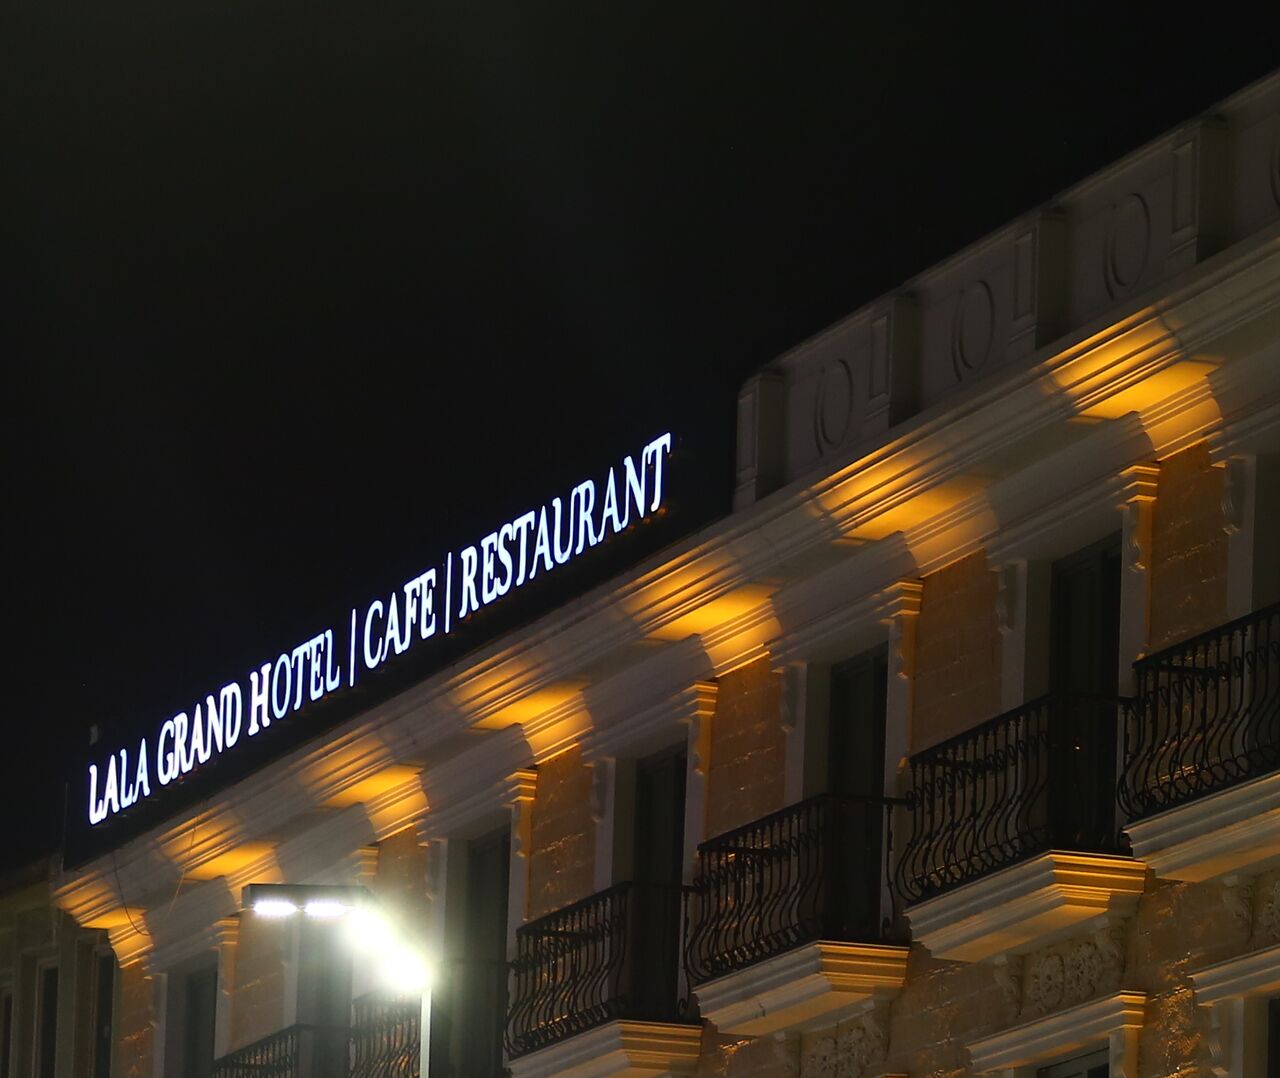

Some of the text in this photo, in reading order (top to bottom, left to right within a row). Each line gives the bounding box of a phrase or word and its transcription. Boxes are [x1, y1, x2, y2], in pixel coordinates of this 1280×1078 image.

[88, 737, 151, 825] LALA
[157, 682, 242, 785] GRAND
[248, 629, 340, 736] HOTEL
[363, 568, 436, 668] CAFE
[459, 432, 671, 618] RESTAURANT
